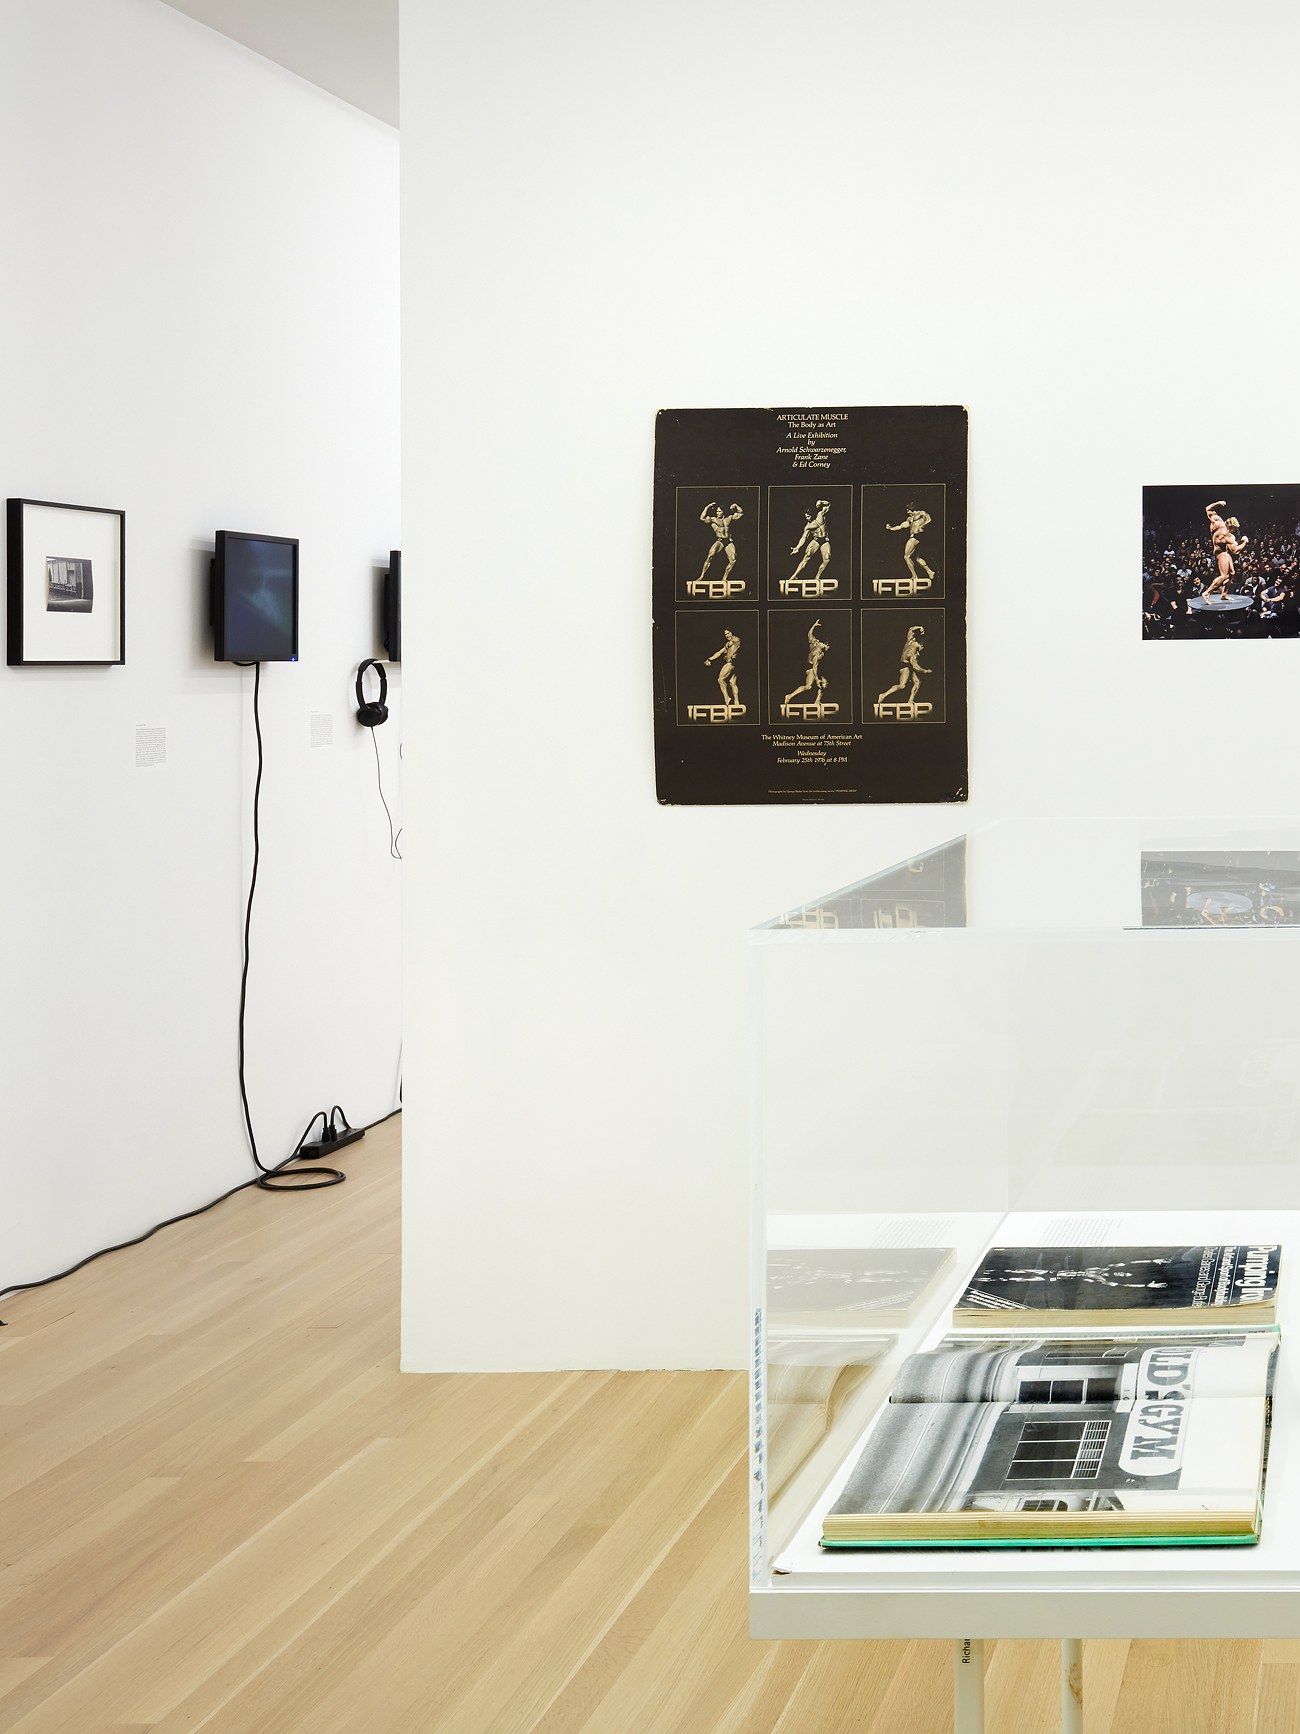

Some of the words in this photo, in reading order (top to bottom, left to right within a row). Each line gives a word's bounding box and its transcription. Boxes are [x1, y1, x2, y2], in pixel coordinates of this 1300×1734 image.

[801, 421, 817, 429] Body
[1235, 1245, 1278, 1287] Pumping
[1130, 1404, 1184, 1460] GYM
